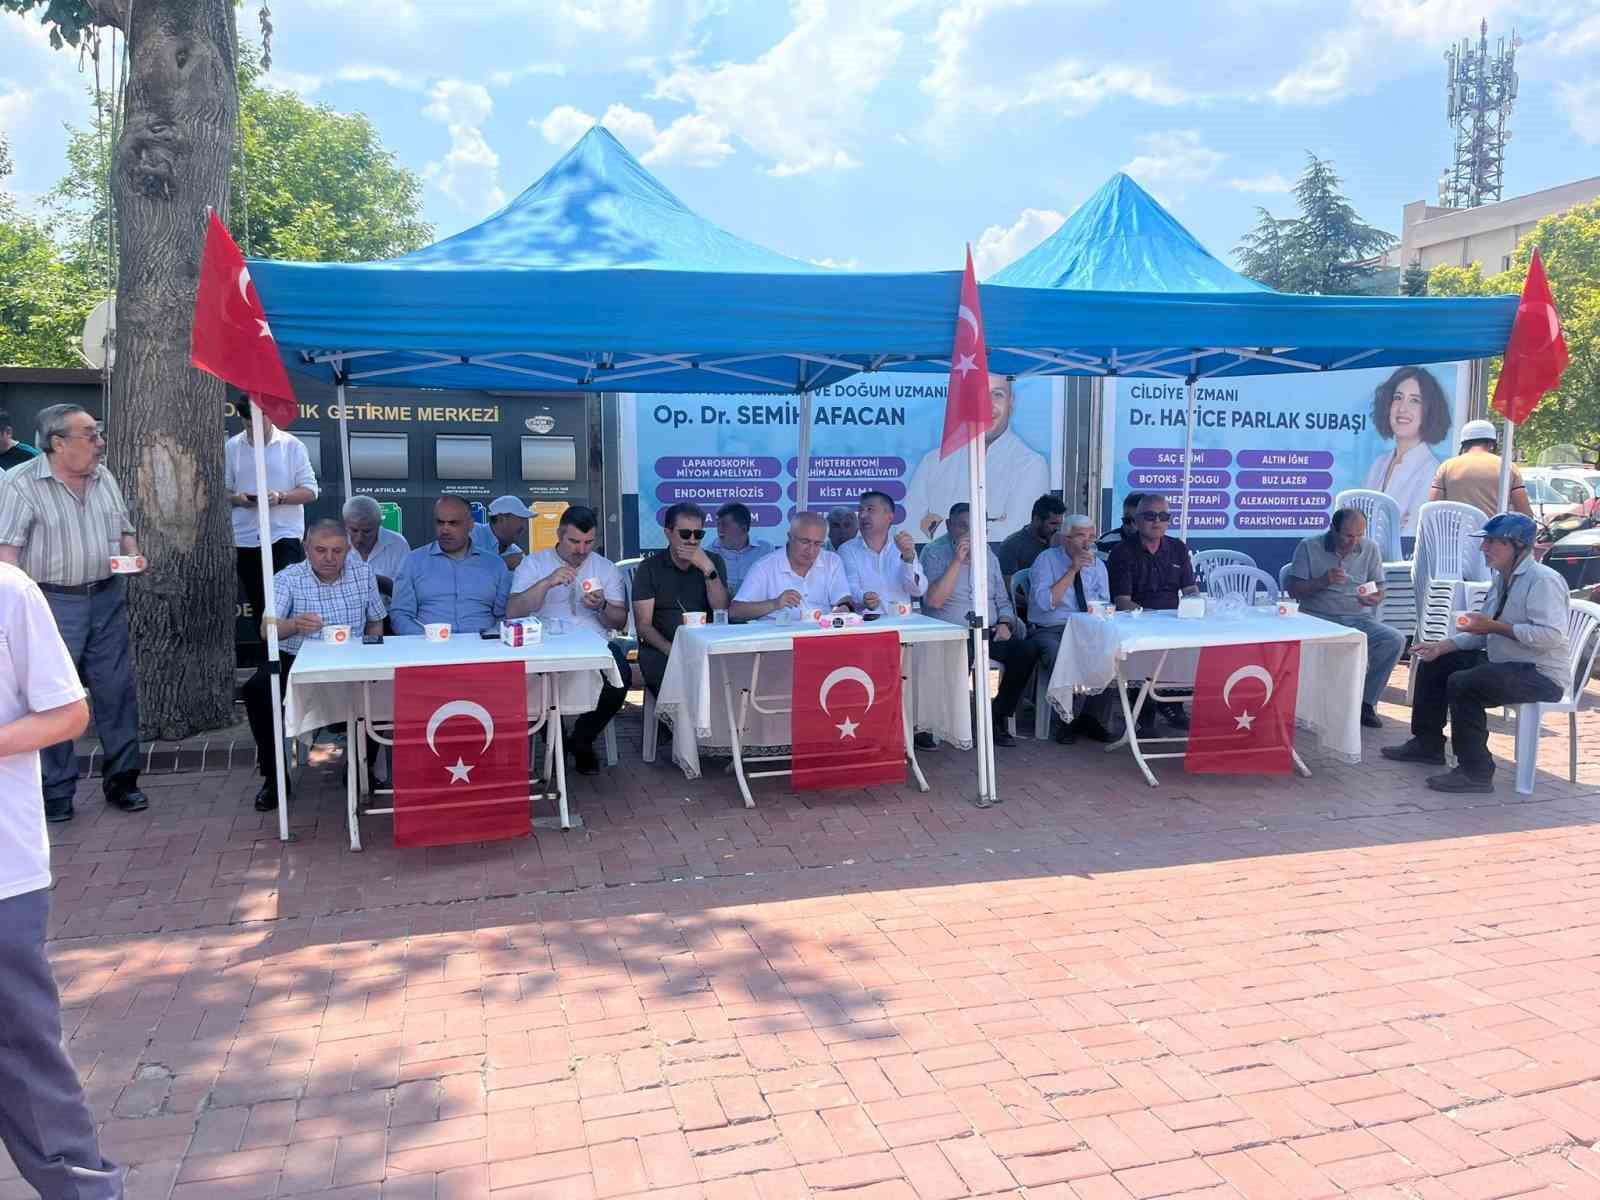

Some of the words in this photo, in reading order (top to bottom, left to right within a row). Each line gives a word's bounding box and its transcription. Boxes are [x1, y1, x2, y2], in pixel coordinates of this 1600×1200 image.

[835, 382, 890, 398] DOĞUM
[895, 386, 947, 398] UZMANI
[1130, 383, 1184, 400] CİLDİYE
[1192, 388, 1239, 401] ZMANI
[327, 402, 412, 421] GETİRME
[417, 405, 499, 422] MERKEZİ
[653, 404, 693, 429] Op.
[701, 405, 731, 425] Dr.
[814, 406, 905, 426] AFACAN
[1129, 408, 1156, 426] Dr.
[1231, 410, 1301, 430] PARLAK
[1305, 412, 1366, 435] SUBAŞI
[682, 458, 756, 468] LAPAROSKOPİK
[815, 458, 880, 467] HİSTEREKTOMİ
[1158, 453, 1177, 465] SAÇ
[1262, 455, 1287, 465] ALTIN
[1288, 453, 1310, 465] İĞNE
[676, 467, 711, 478] MİYOM
[713, 468, 762, 478] AMELİYATI
[828, 469, 852, 477] ALMA
[1139, 474, 1177, 485] BOTOKS
[1187, 475, 1220, 485] DOLGU
[1262, 475, 1279, 485] BUZ
[1281, 476, 1308, 485] LAZER
[674, 486, 765, 499] ENDOMETRİOZİS
[820, 485, 844, 498] KİST
[1165, 493, 1221, 505] MEZTERAPİ
[1300, 497, 1327, 506] LAZER
[1239, 515, 1297, 526] FRAKSİYONEL
[1299, 516, 1325, 526] LAZER
